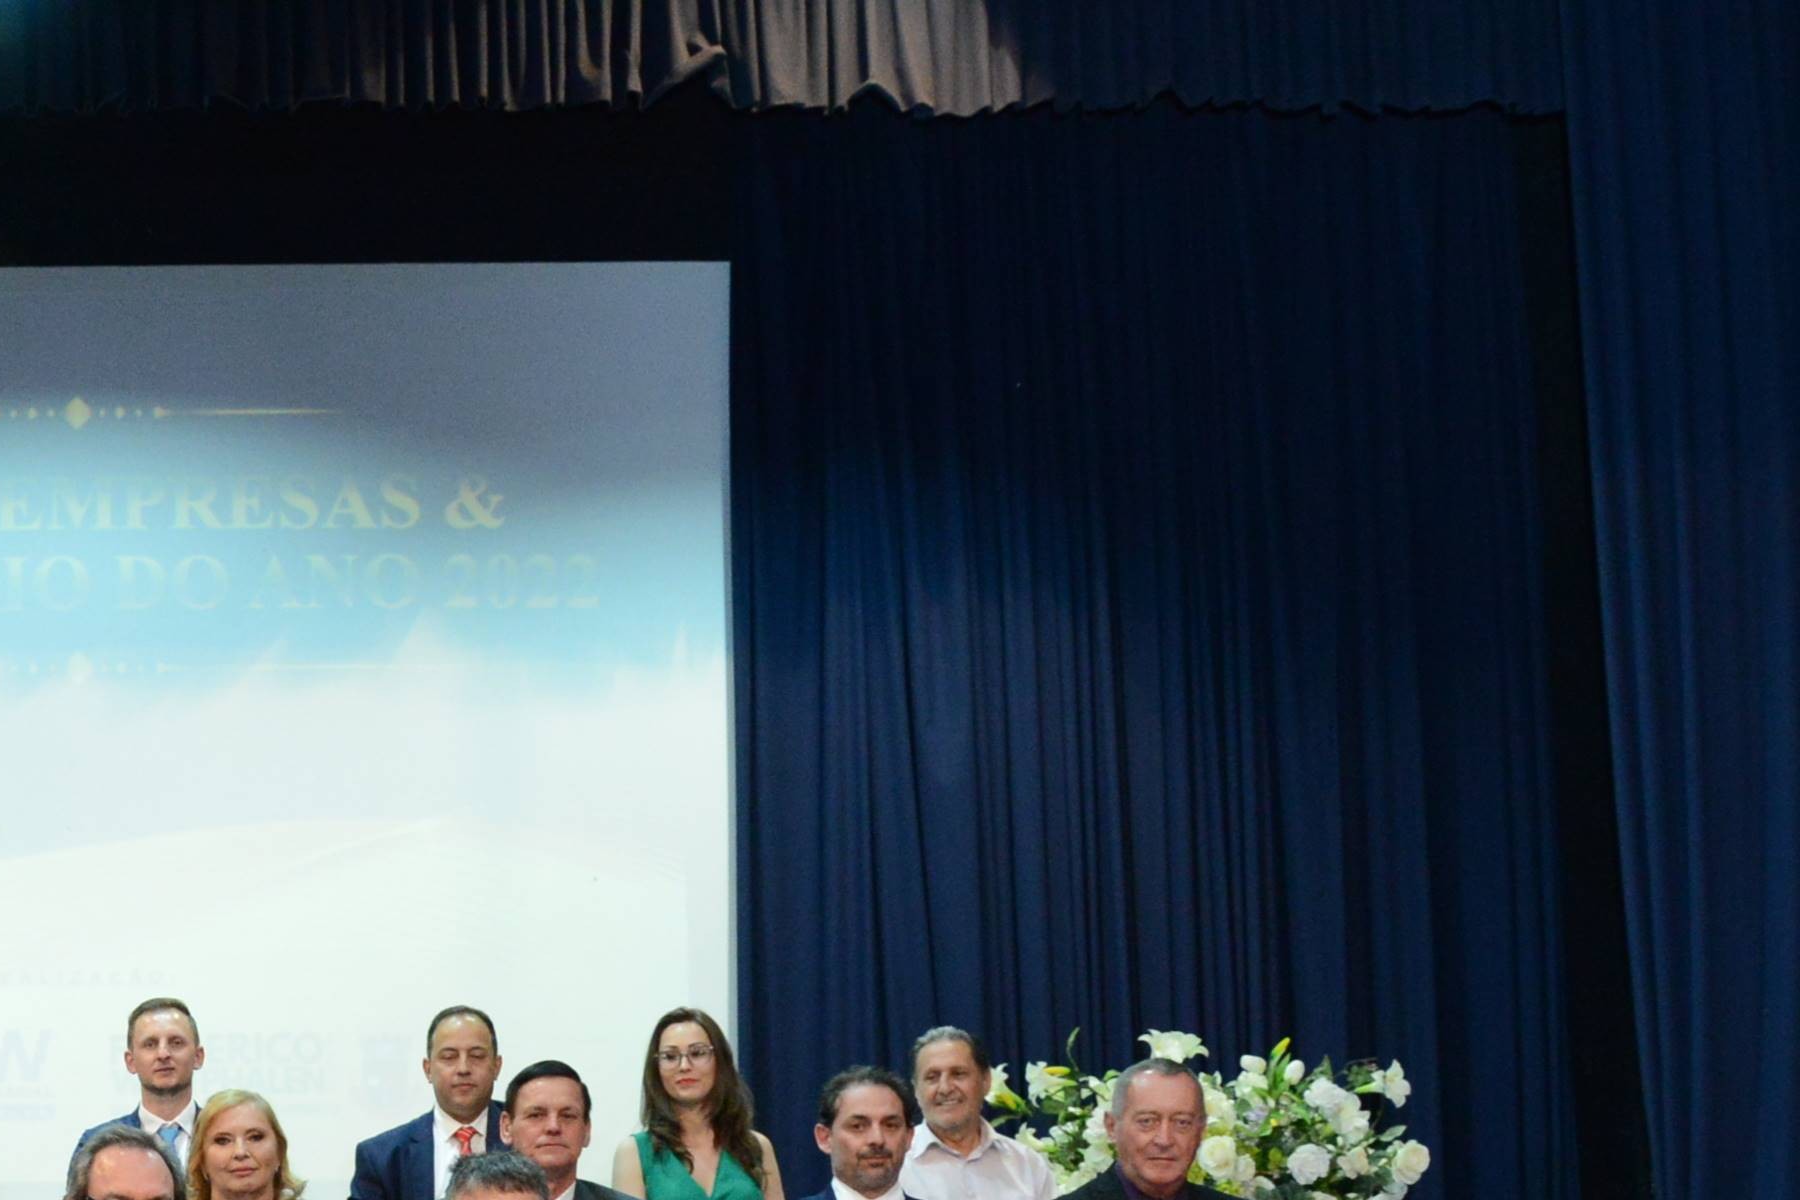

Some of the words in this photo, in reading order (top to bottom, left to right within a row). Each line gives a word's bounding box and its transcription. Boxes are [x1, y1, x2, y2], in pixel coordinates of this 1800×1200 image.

[444, 473, 506, 531] &
[114, 553, 229, 612] DO
[247, 552, 421, 611] ANO
[441, 551, 602, 609] 2022
